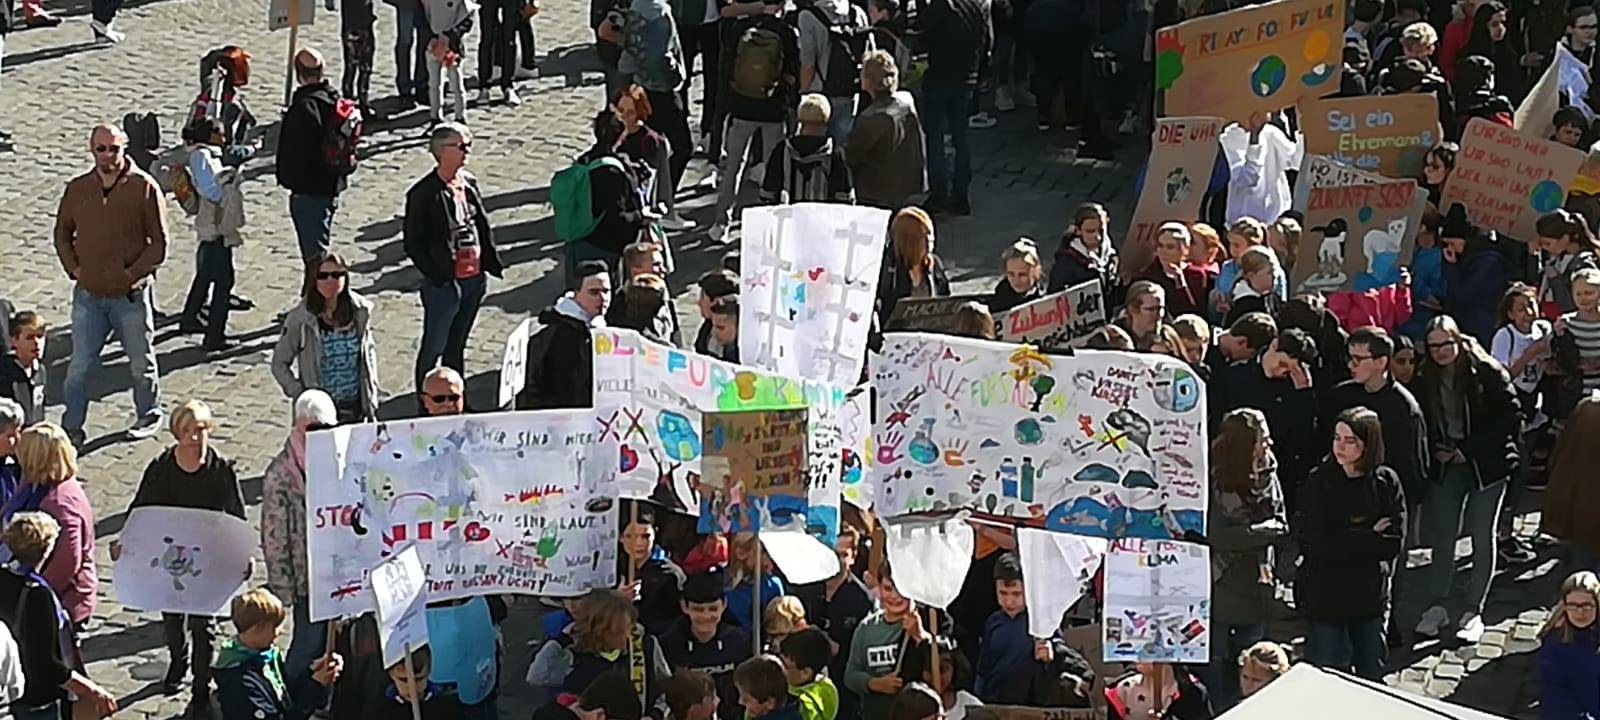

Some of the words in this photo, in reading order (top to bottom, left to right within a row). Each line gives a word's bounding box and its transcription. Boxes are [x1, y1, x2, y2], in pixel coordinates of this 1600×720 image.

[1328, 110, 1355, 131] Sei
[1366, 110, 1393, 127] ein
[1159, 125, 1185, 144] DIE
[1008, 293, 1071, 335] Zukunft
[1077, 291, 1100, 316] der
[517, 430, 549, 449] SIND
